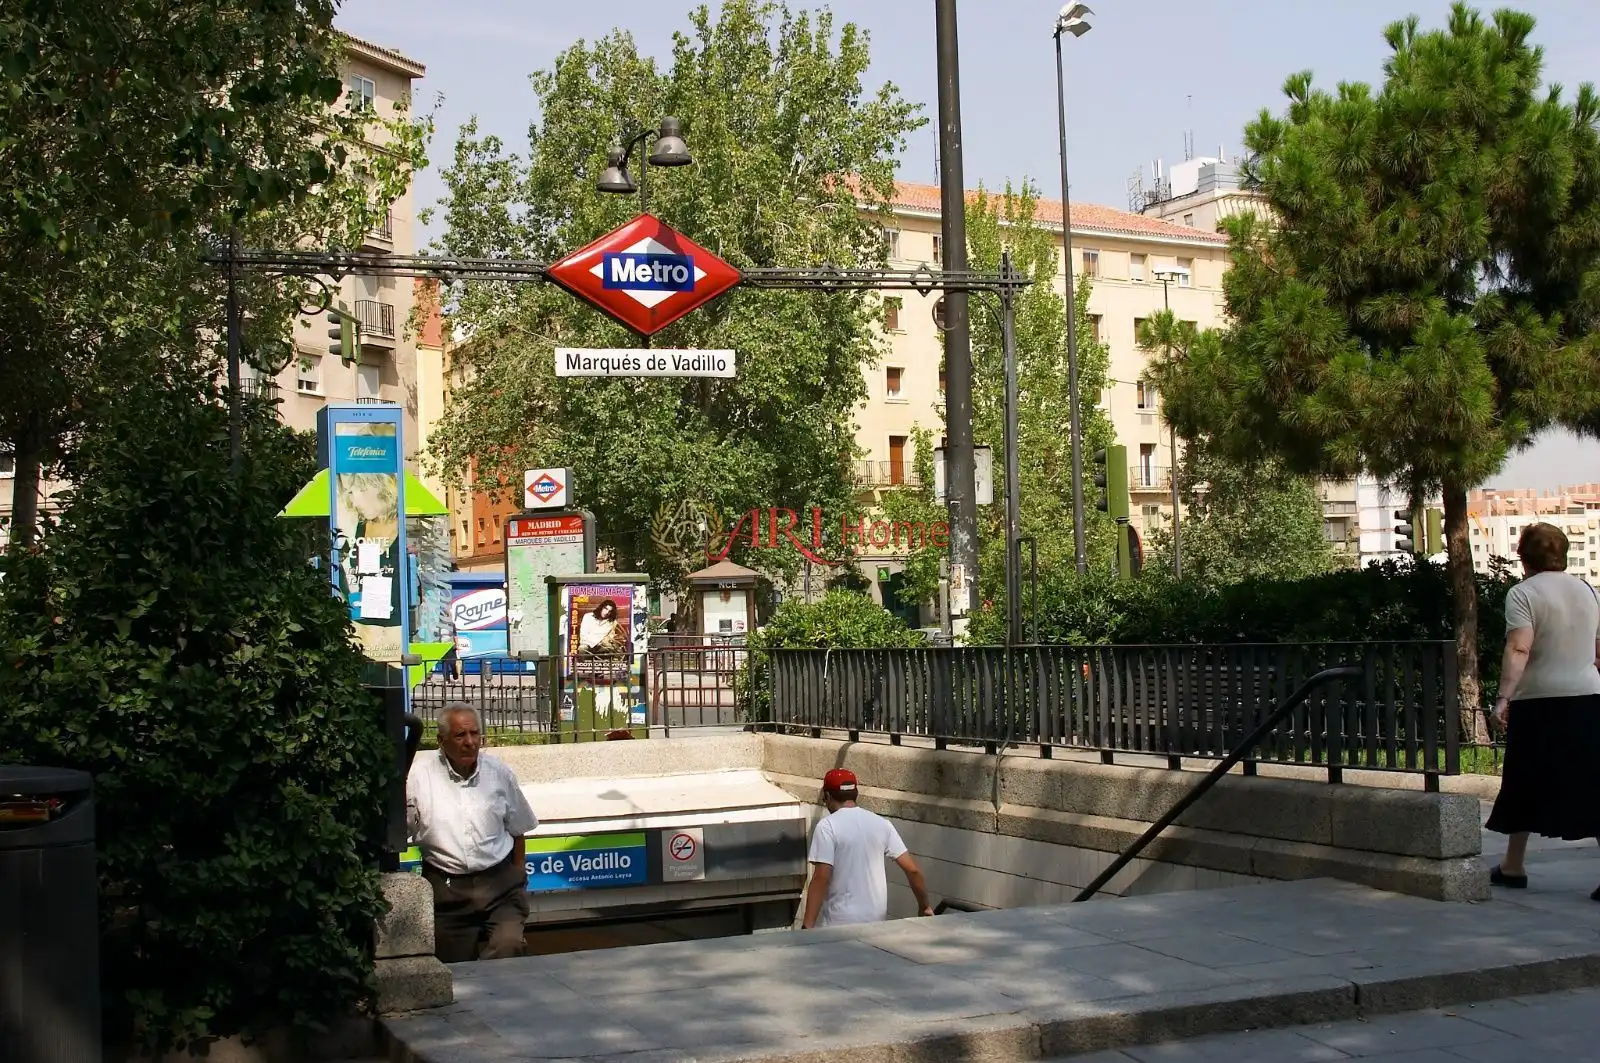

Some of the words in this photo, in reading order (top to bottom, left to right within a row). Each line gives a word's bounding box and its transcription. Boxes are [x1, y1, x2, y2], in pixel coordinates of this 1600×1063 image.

[611, 257, 690, 284] Metro
[566, 353, 641, 374] Marqués
[646, 355, 667, 371] de
[671, 354, 727, 371] Vadillo
[534, 484, 555, 492] Metro
[528, 520, 561, 530] MADRID
[454, 597, 507, 626] Royne
[540, 856, 565, 874] de
[568, 852, 632, 872] Vadillo
[590, 873, 614, 881] Antonio
